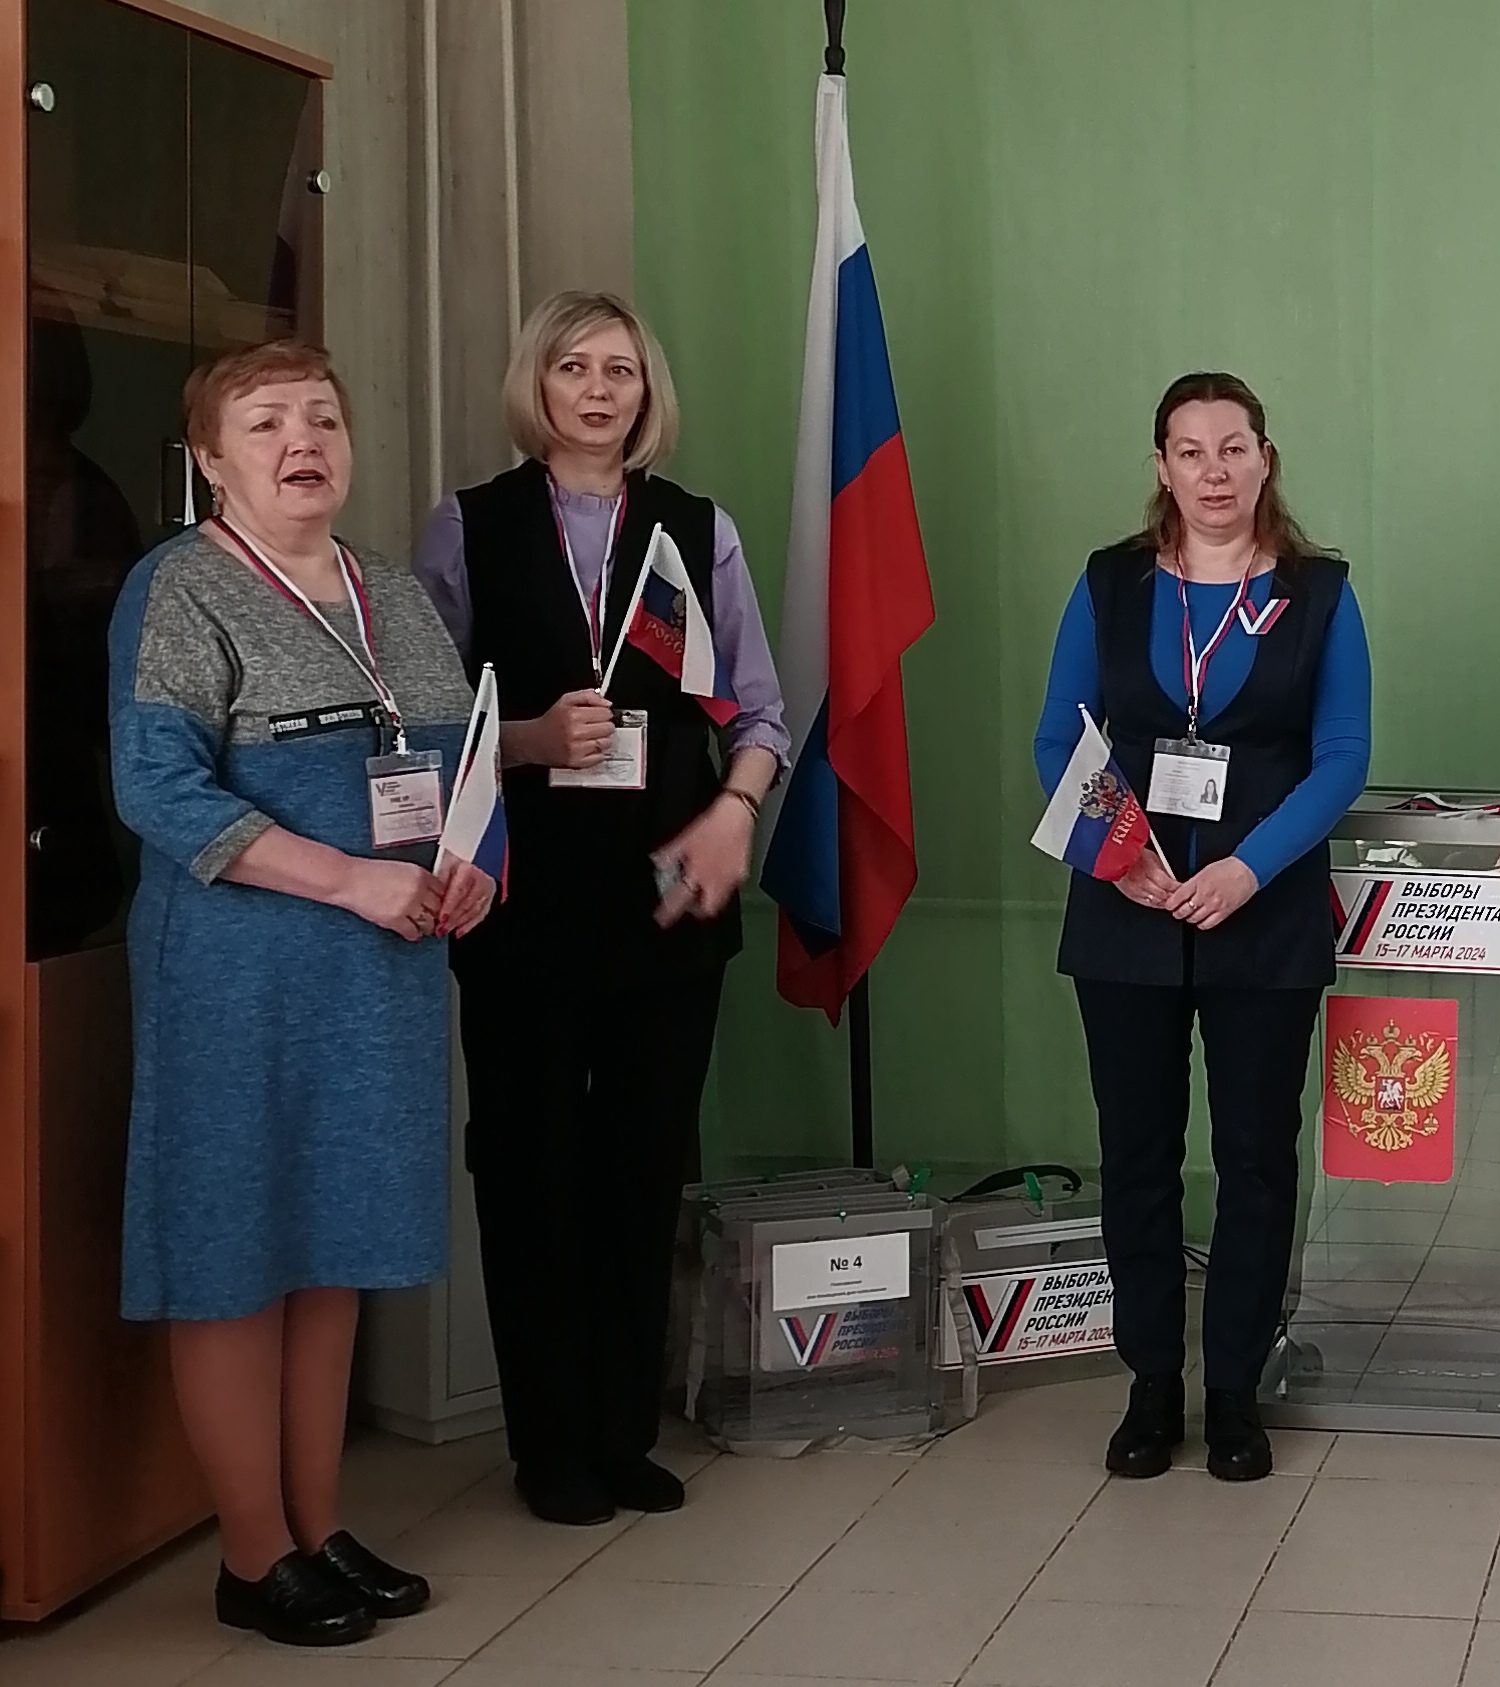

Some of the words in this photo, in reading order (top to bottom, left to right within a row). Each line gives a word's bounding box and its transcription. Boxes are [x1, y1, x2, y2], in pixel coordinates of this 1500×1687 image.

[645, 620, 684, 654] РОСС
[1401, 881, 1481, 900] ВЫБОРЫ
[1381, 923, 1455, 941] РОССИИ
[1410, 945, 1453, 960] МАРТА
[1455, 946, 1487, 961] 2024
[830, 1257, 849, 1272] №
[852, 1255, 863, 1269] 4
[1042, 1270, 1111, 1291] ВЫБОРЫ
[1033, 1289, 1114, 1313] ПРЕЗИДЕН
[1024, 1311, 1088, 1333] РОССИИ
[1049, 1330, 1087, 1347] МАРТА
[1087, 1326, 1114, 1342] 2024
